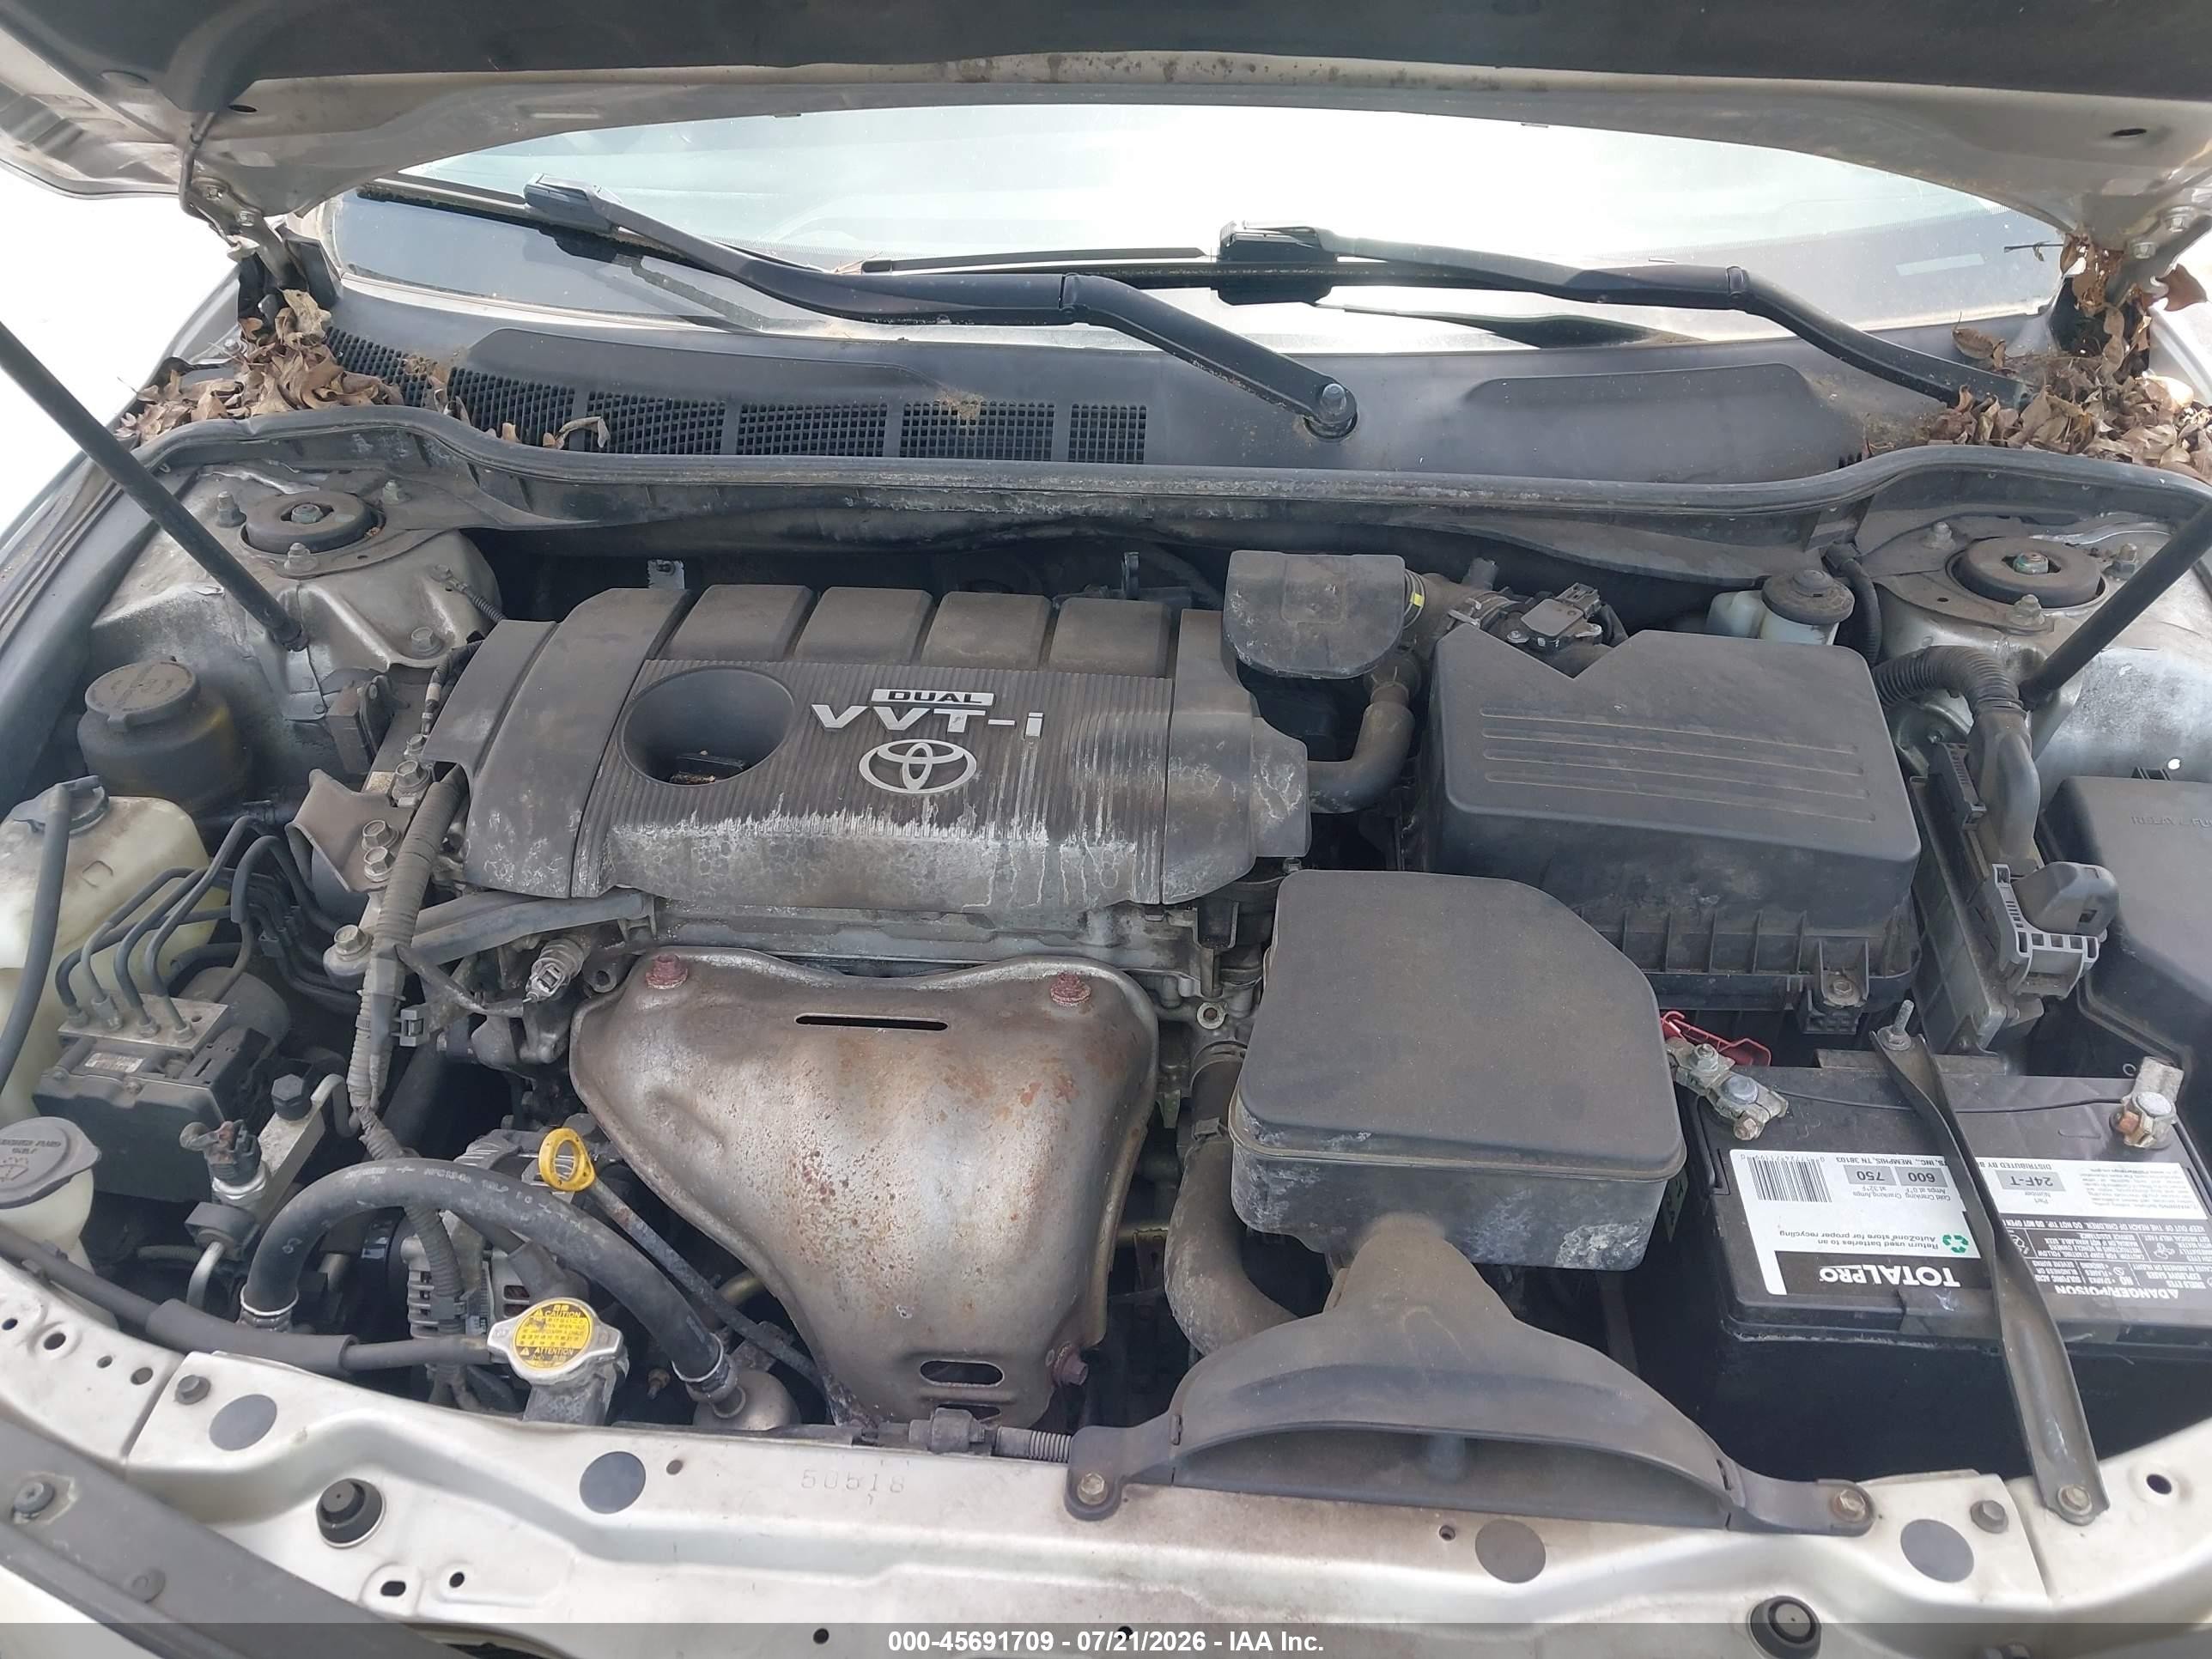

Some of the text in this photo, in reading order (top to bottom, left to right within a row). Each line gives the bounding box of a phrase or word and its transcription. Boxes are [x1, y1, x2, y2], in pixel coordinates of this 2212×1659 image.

[888, 690, 981, 704] DUAL
[811, 704, 1043, 738] VVT-i
[2000, 1162, 2051, 1170] DISTRIBUTED
[1856, 1170, 1886, 1182] 750
[1907, 1172, 1936, 1182] 600
[2009, 1176, 2053, 1187] 24F-T
[1905, 1192, 1936, 1200] Cranking
[1820, 1264, 1960, 1287] TOTALPRO
[2033, 1274, 2051, 1283] ACID
[2119, 1276, 2134, 1285] NO
[2054, 1285, 2170, 1299] DANGER/POISON
[534, 1346, 574, 1356] ATTENTION
